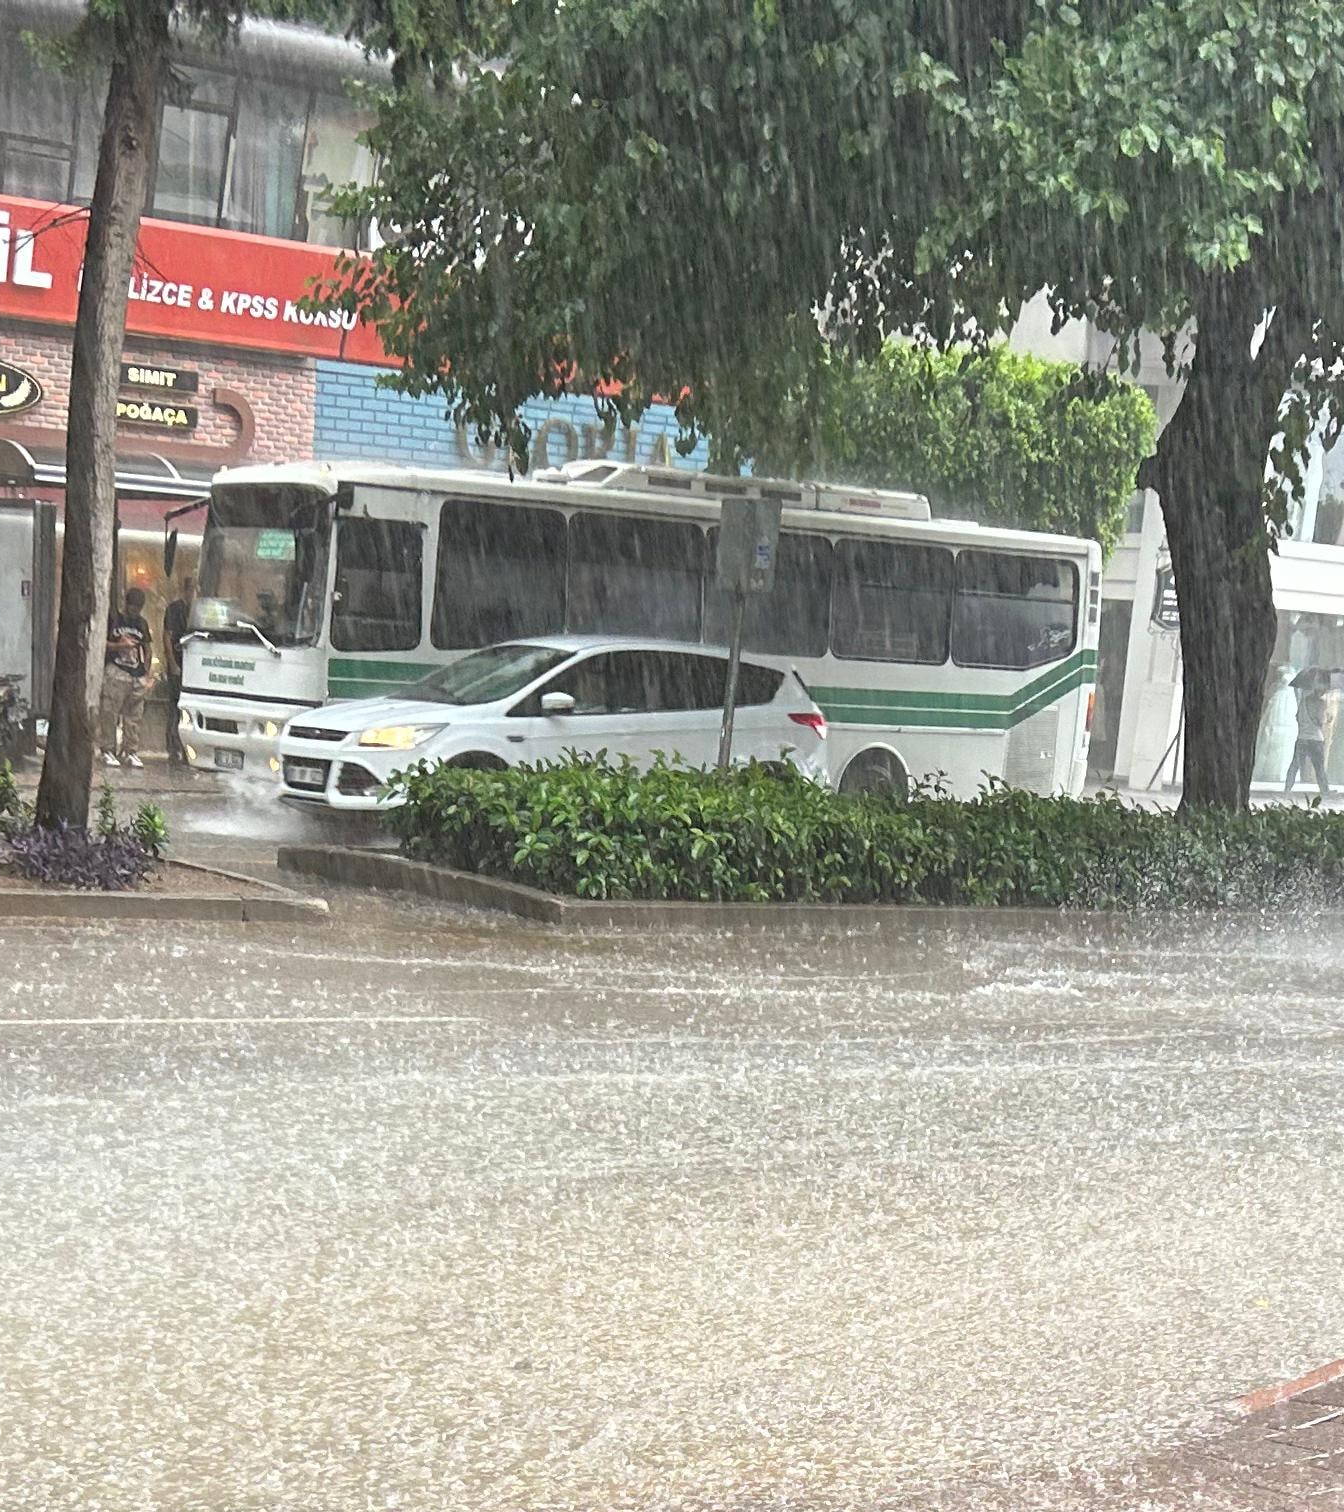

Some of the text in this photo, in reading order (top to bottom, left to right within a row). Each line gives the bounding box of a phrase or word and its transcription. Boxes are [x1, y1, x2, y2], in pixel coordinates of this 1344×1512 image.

[198, 288, 214, 310] &
[220, 291, 279, 320] KPSS
[116, 402, 188, 426] POĞAÇA
